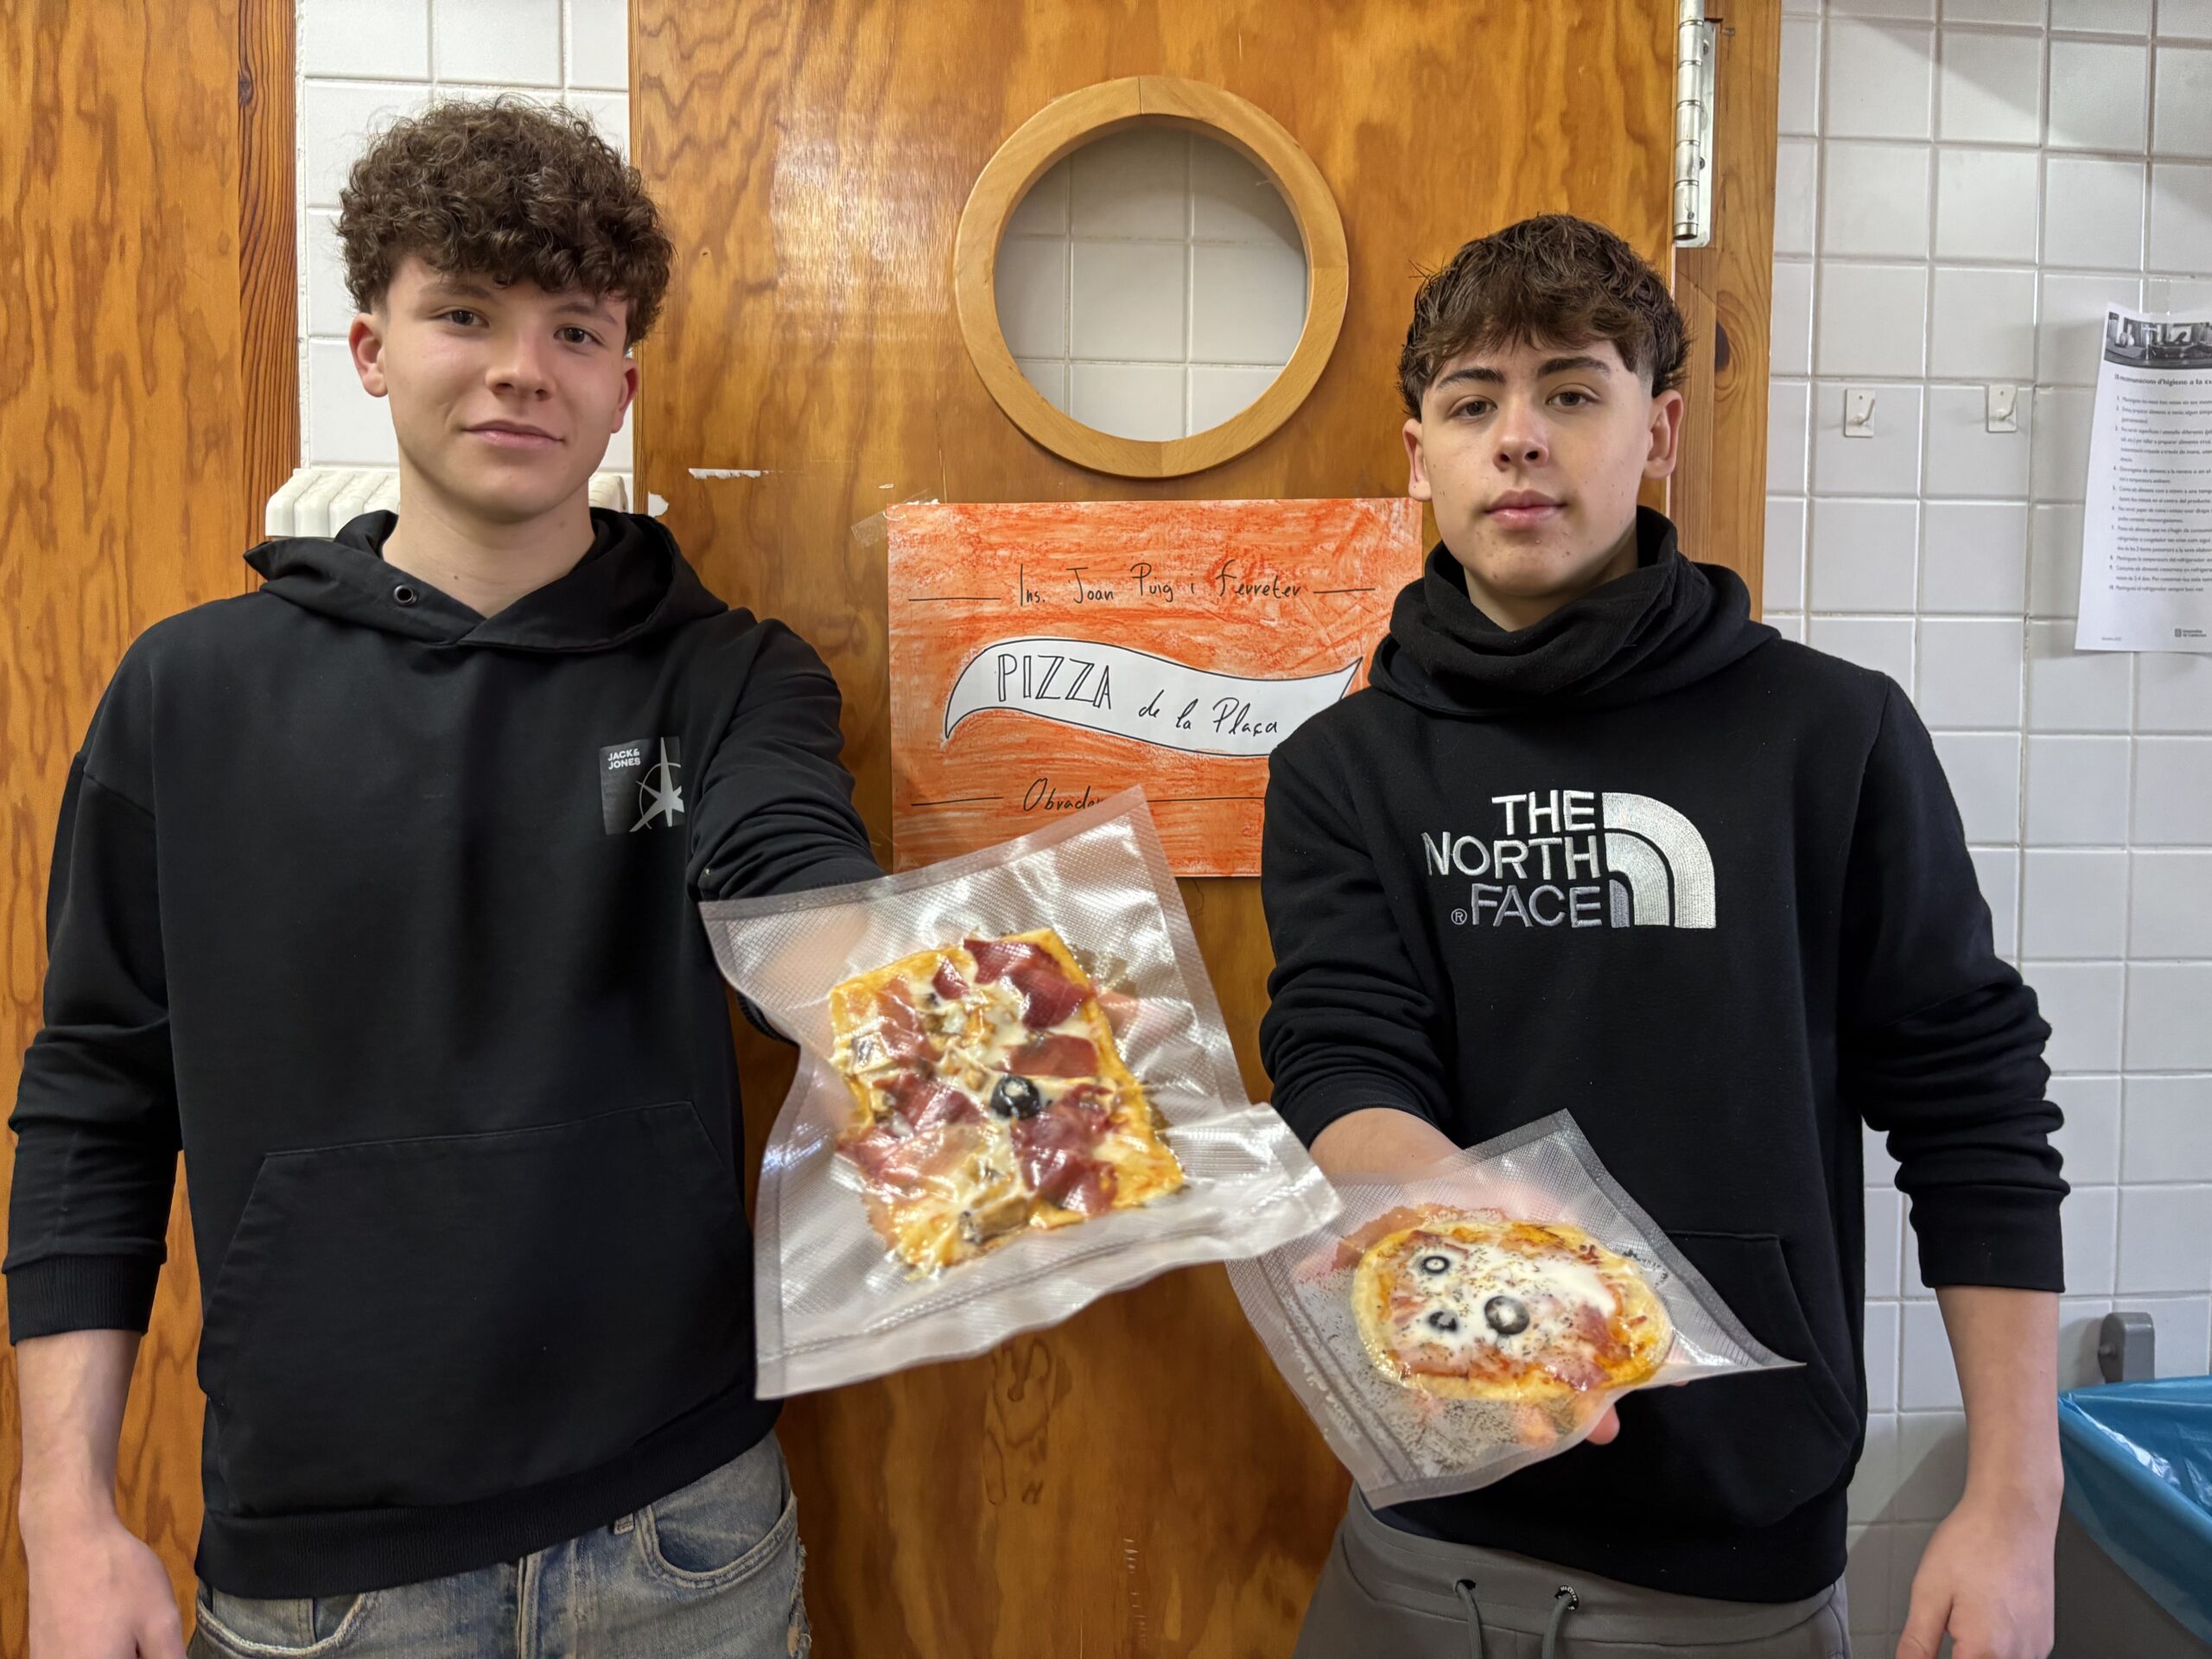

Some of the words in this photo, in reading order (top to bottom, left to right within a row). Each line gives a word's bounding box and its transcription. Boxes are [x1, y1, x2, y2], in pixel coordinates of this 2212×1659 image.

[1020, 563, 1046, 607] Ins.
[1065, 567, 1114, 604] Joan
[1130, 563, 1174, 603] Puig
[1189, 573, 1196, 595] i
[1215, 559, 1301, 599] Ferreter
[997, 653, 1112, 710] PIZZA
[1138, 689, 1165, 719] de
[1175, 698, 1199, 730] la
[1211, 696, 1279, 737] Plaça
[607, 748, 639, 761] JACK&
[608, 758, 640, 770] JONES
[1491, 790, 1595, 835] THE
[1421, 831, 1601, 880] NORTH
[1471, 883, 1602, 928] FACE
